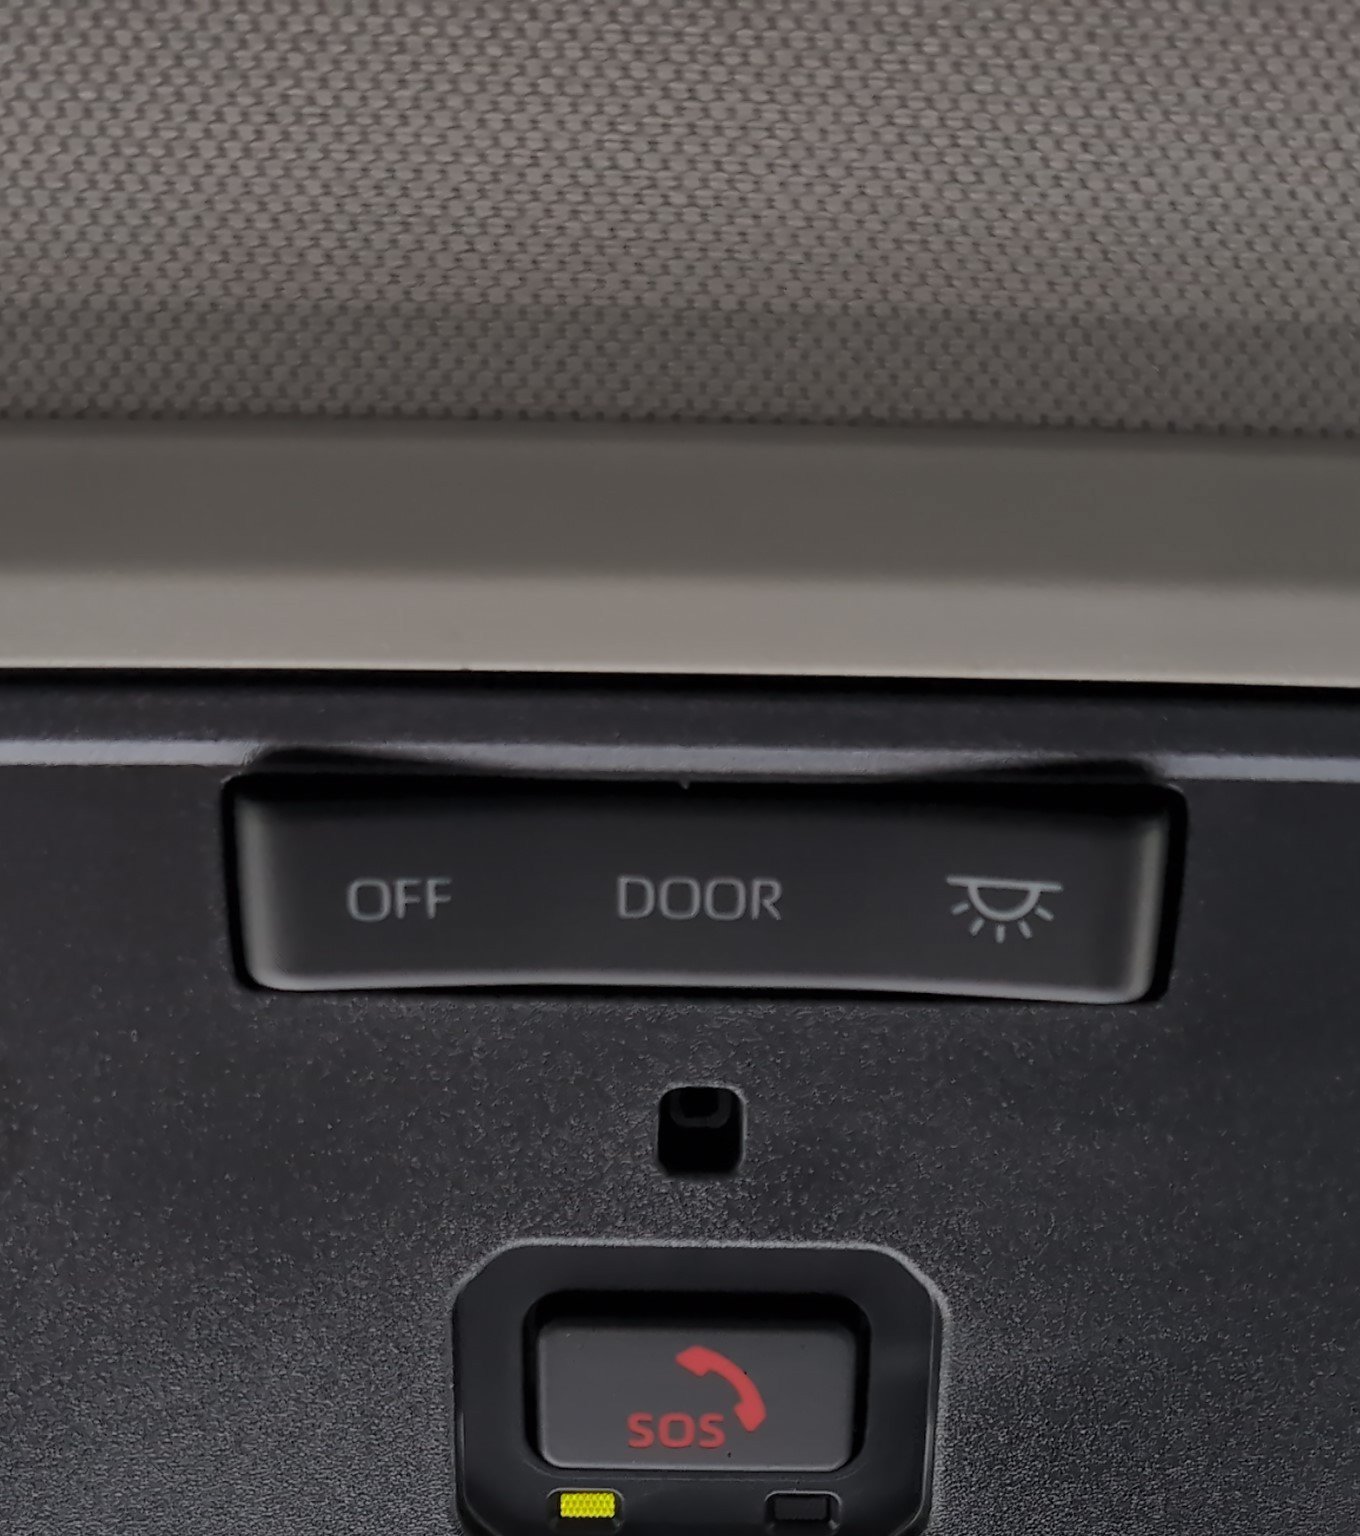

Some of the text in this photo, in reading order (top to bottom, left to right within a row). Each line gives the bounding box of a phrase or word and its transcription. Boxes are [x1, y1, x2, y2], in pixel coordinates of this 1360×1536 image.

[346, 875, 453, 924] OFF
[617, 876, 784, 922] DOOR
[626, 1411, 727, 1449] SOS
